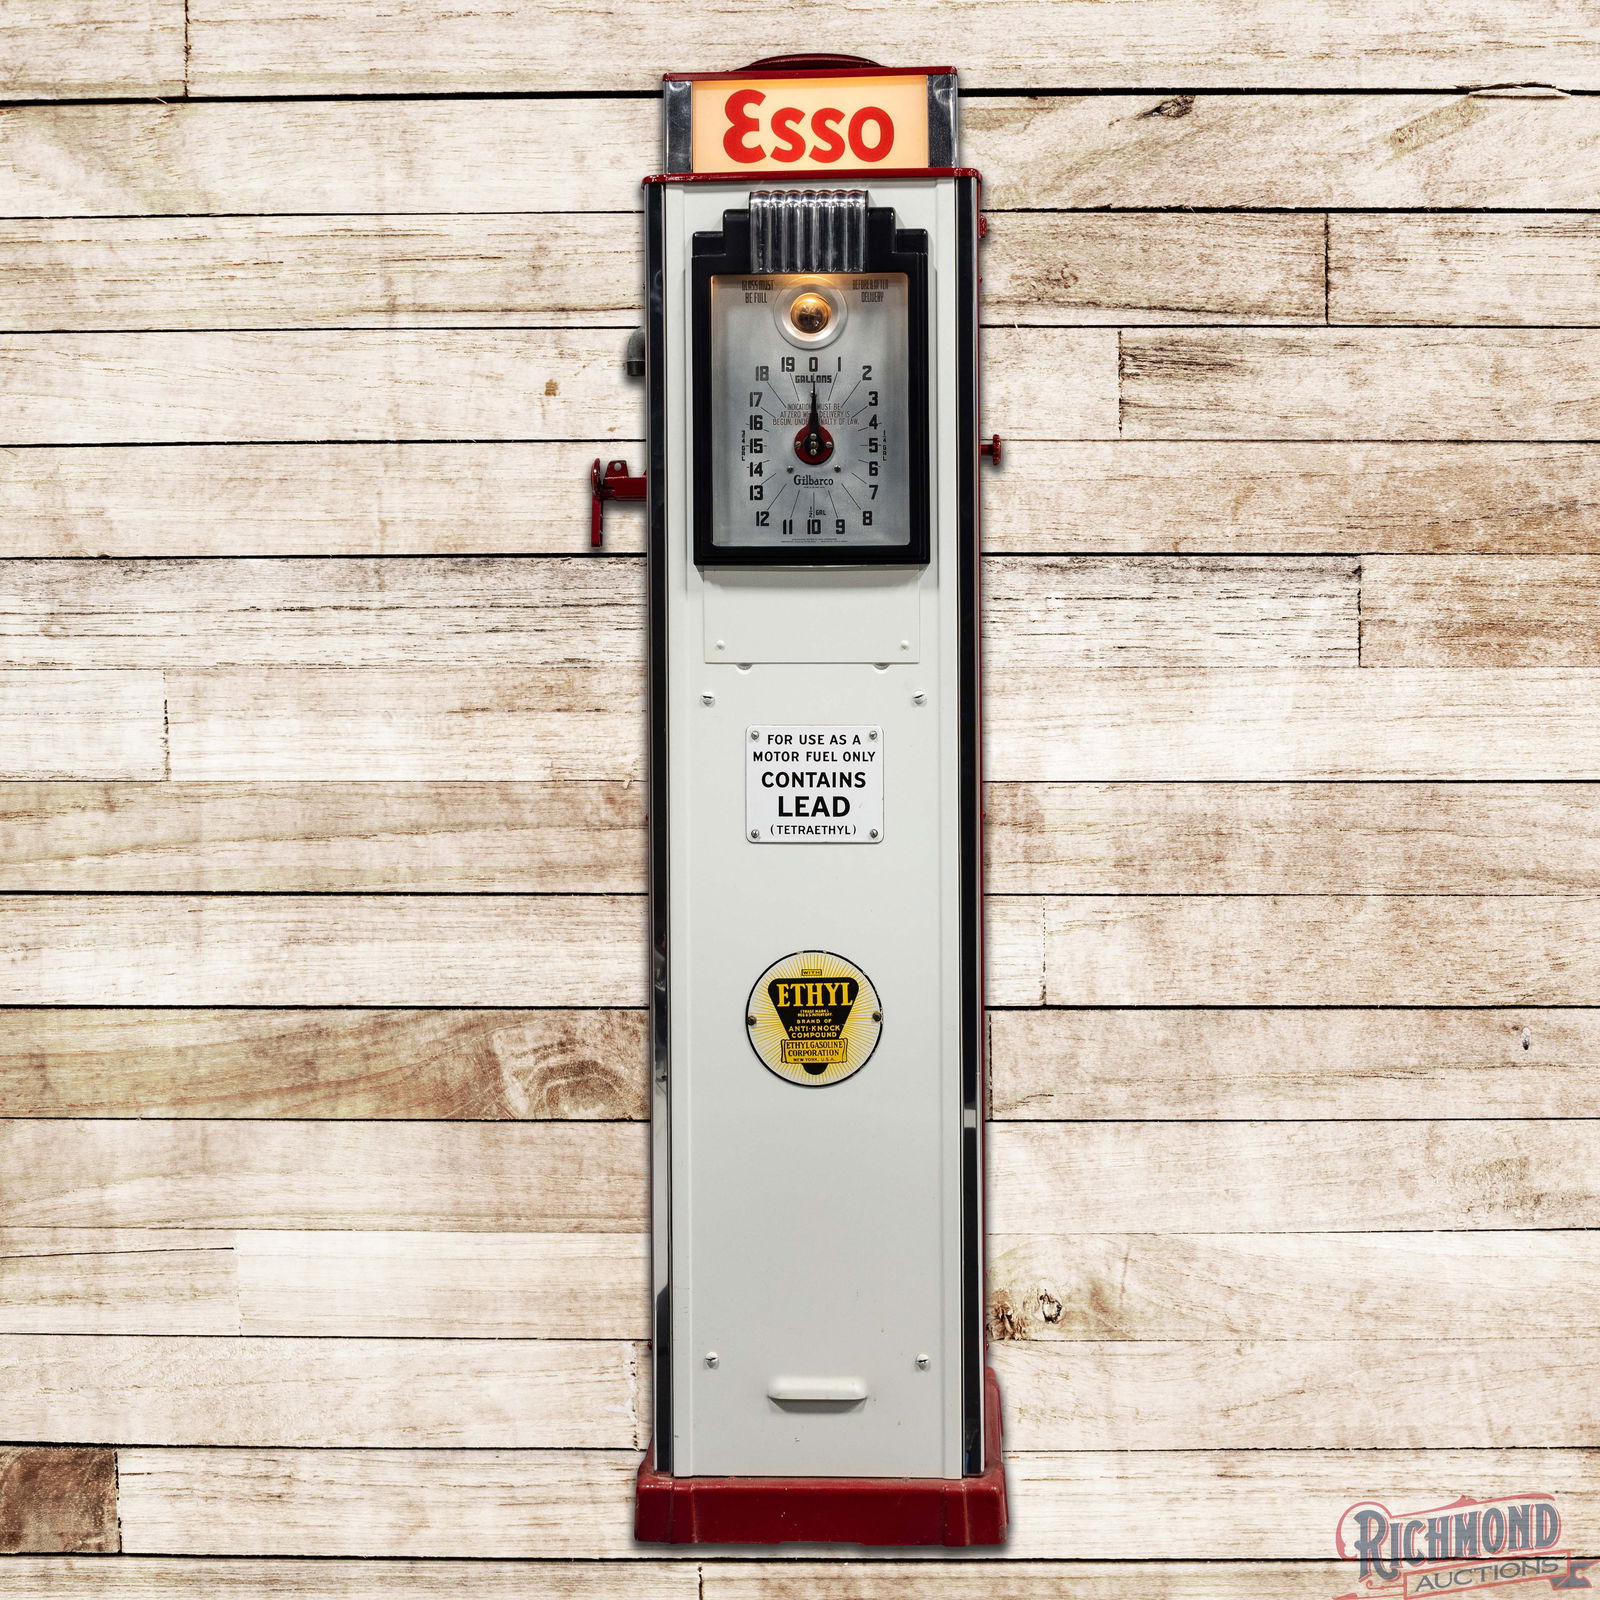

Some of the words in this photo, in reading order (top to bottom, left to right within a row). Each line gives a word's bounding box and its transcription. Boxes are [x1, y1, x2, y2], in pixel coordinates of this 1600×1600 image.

[723, 89, 895, 163] Esso
[759, 279, 774, 290] MUST
[745, 292, 753, 303] BE
[754, 292, 767, 303] FULL
[861, 291, 884, 303] DELIVERY
[781, 356, 795, 372] 19
[809, 356, 818, 372] 0
[837, 356, 841, 372] 1
[755, 365, 769, 381] 18
[795, 375, 832, 383] GALLONS
[862, 365, 872, 381] 2
[749, 391, 762, 407] 17
[868, 391, 878, 407] 3
[749, 415, 763, 430] 16
[869, 414, 878, 429] 4
[749, 438, 763, 453] 15
[869, 438, 878, 453] 5
[749, 462, 763, 477] 14
[869, 461, 878, 476] 6
[793, 474, 834, 486] Gilbarco
[749, 485, 763, 501] 13
[869, 485, 878, 500] 7
[756, 511, 769, 526] 12
[862, 511, 873, 526] 8
[782, 519, 793, 535] 11
[807, 519, 821, 535] 10
[835, 519, 845, 535] 9
[767, 734, 793, 745] FOR
[799, 734, 825, 745] USE
[829, 734, 847, 745] AS
[852, 734, 861, 745] A
[753, 751, 800, 762] MOTOR
[806, 751, 838, 762] FUEL
[843, 751, 876, 762] ONLY
[761, 771, 866, 788] CONTAINS
[778, 796, 851, 818] LEAD
[770, 824, 857, 836] (TETRAETHYL)
[776, 982, 854, 1007] ETHYL
[786, 1041, 809, 1049] ETHYL
[810, 1041, 844, 1049] GASOLINE
[788, 1049, 839, 1057] CORPORATION
